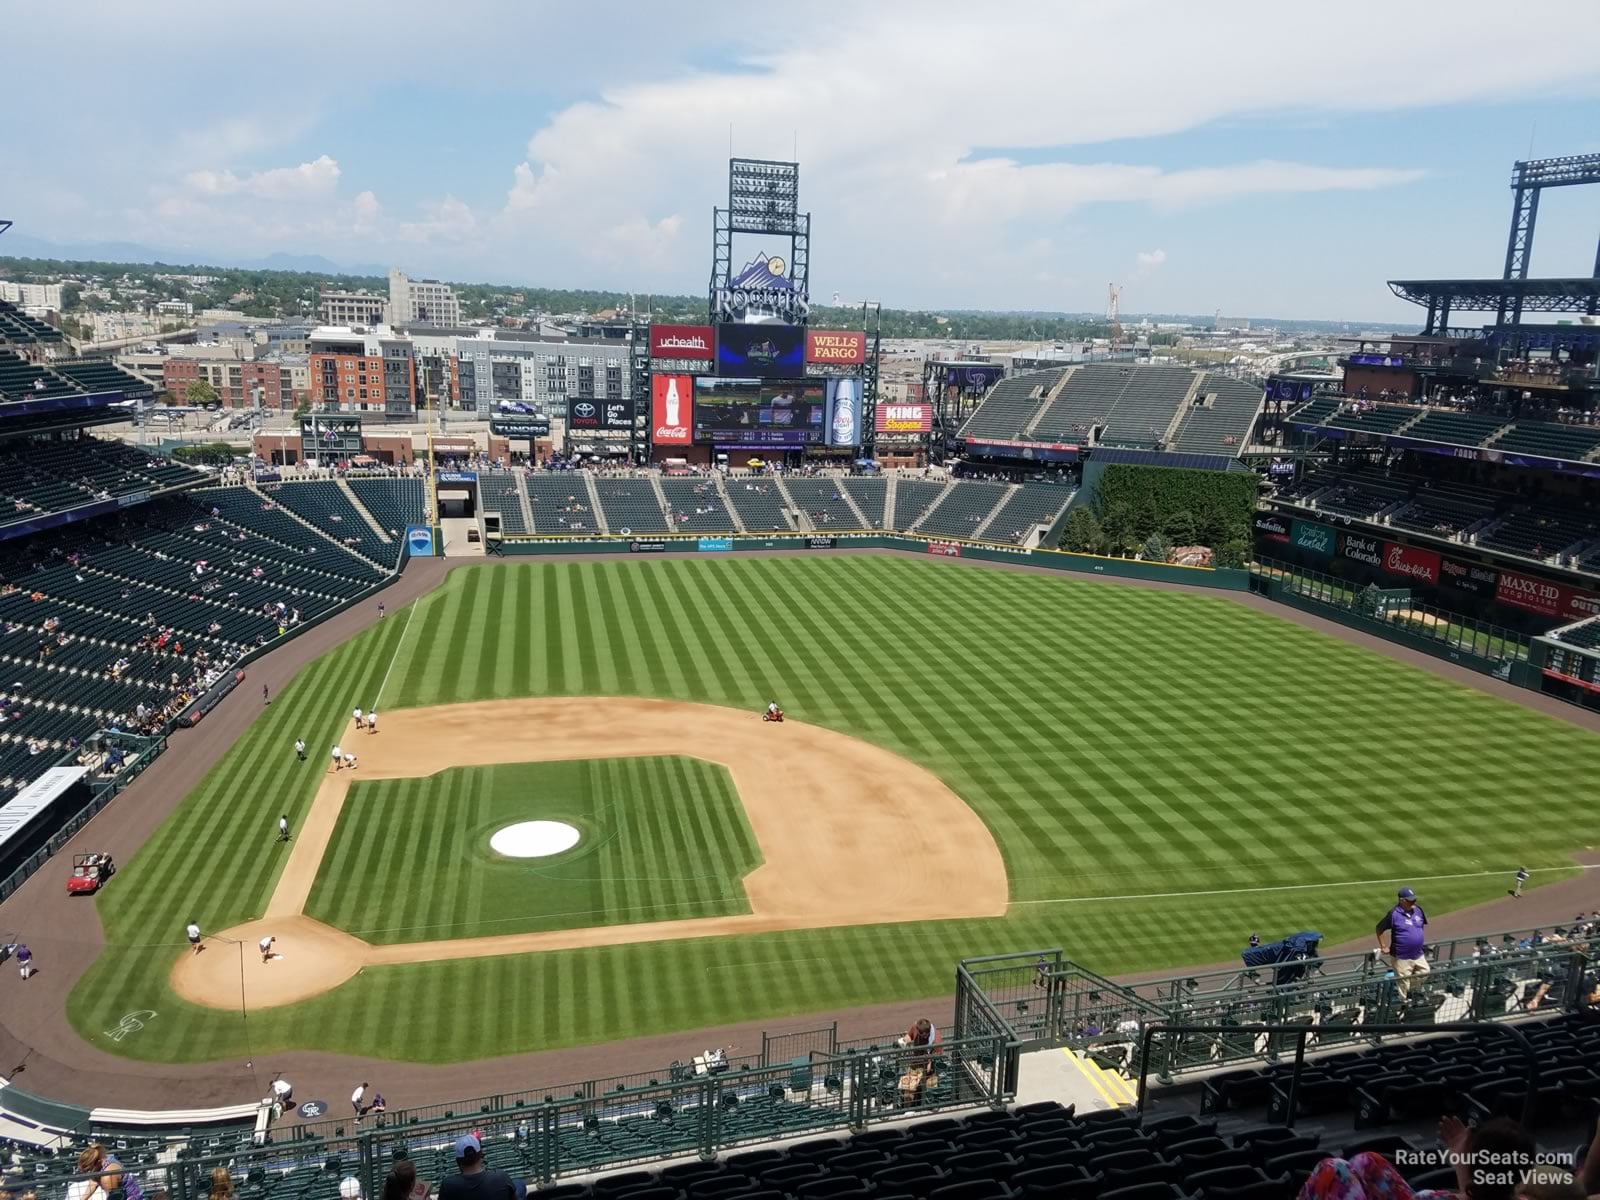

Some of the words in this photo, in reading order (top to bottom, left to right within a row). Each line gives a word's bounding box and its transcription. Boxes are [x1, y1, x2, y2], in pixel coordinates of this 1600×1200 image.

[660, 335, 705, 348] uchealth
[814, 336, 858, 347] WELLS
[814, 347, 858, 359] FARGO
[886, 407, 922, 419] KING
[495, 424, 548, 433] TUNDRA
[885, 420, 922, 431] Soopers
[656, 427, 689, 438] Coca-Cola
[1256, 519, 1286, 534] Safelite
[1298, 534, 1328, 552] dental
[1346, 536, 1366, 550] Bank
[1366, 541, 1377, 552] of
[1345, 547, 1381, 565] Colorado
[1500, 575, 1538, 595] MAXX
[1540, 584, 1559, 599] HD
